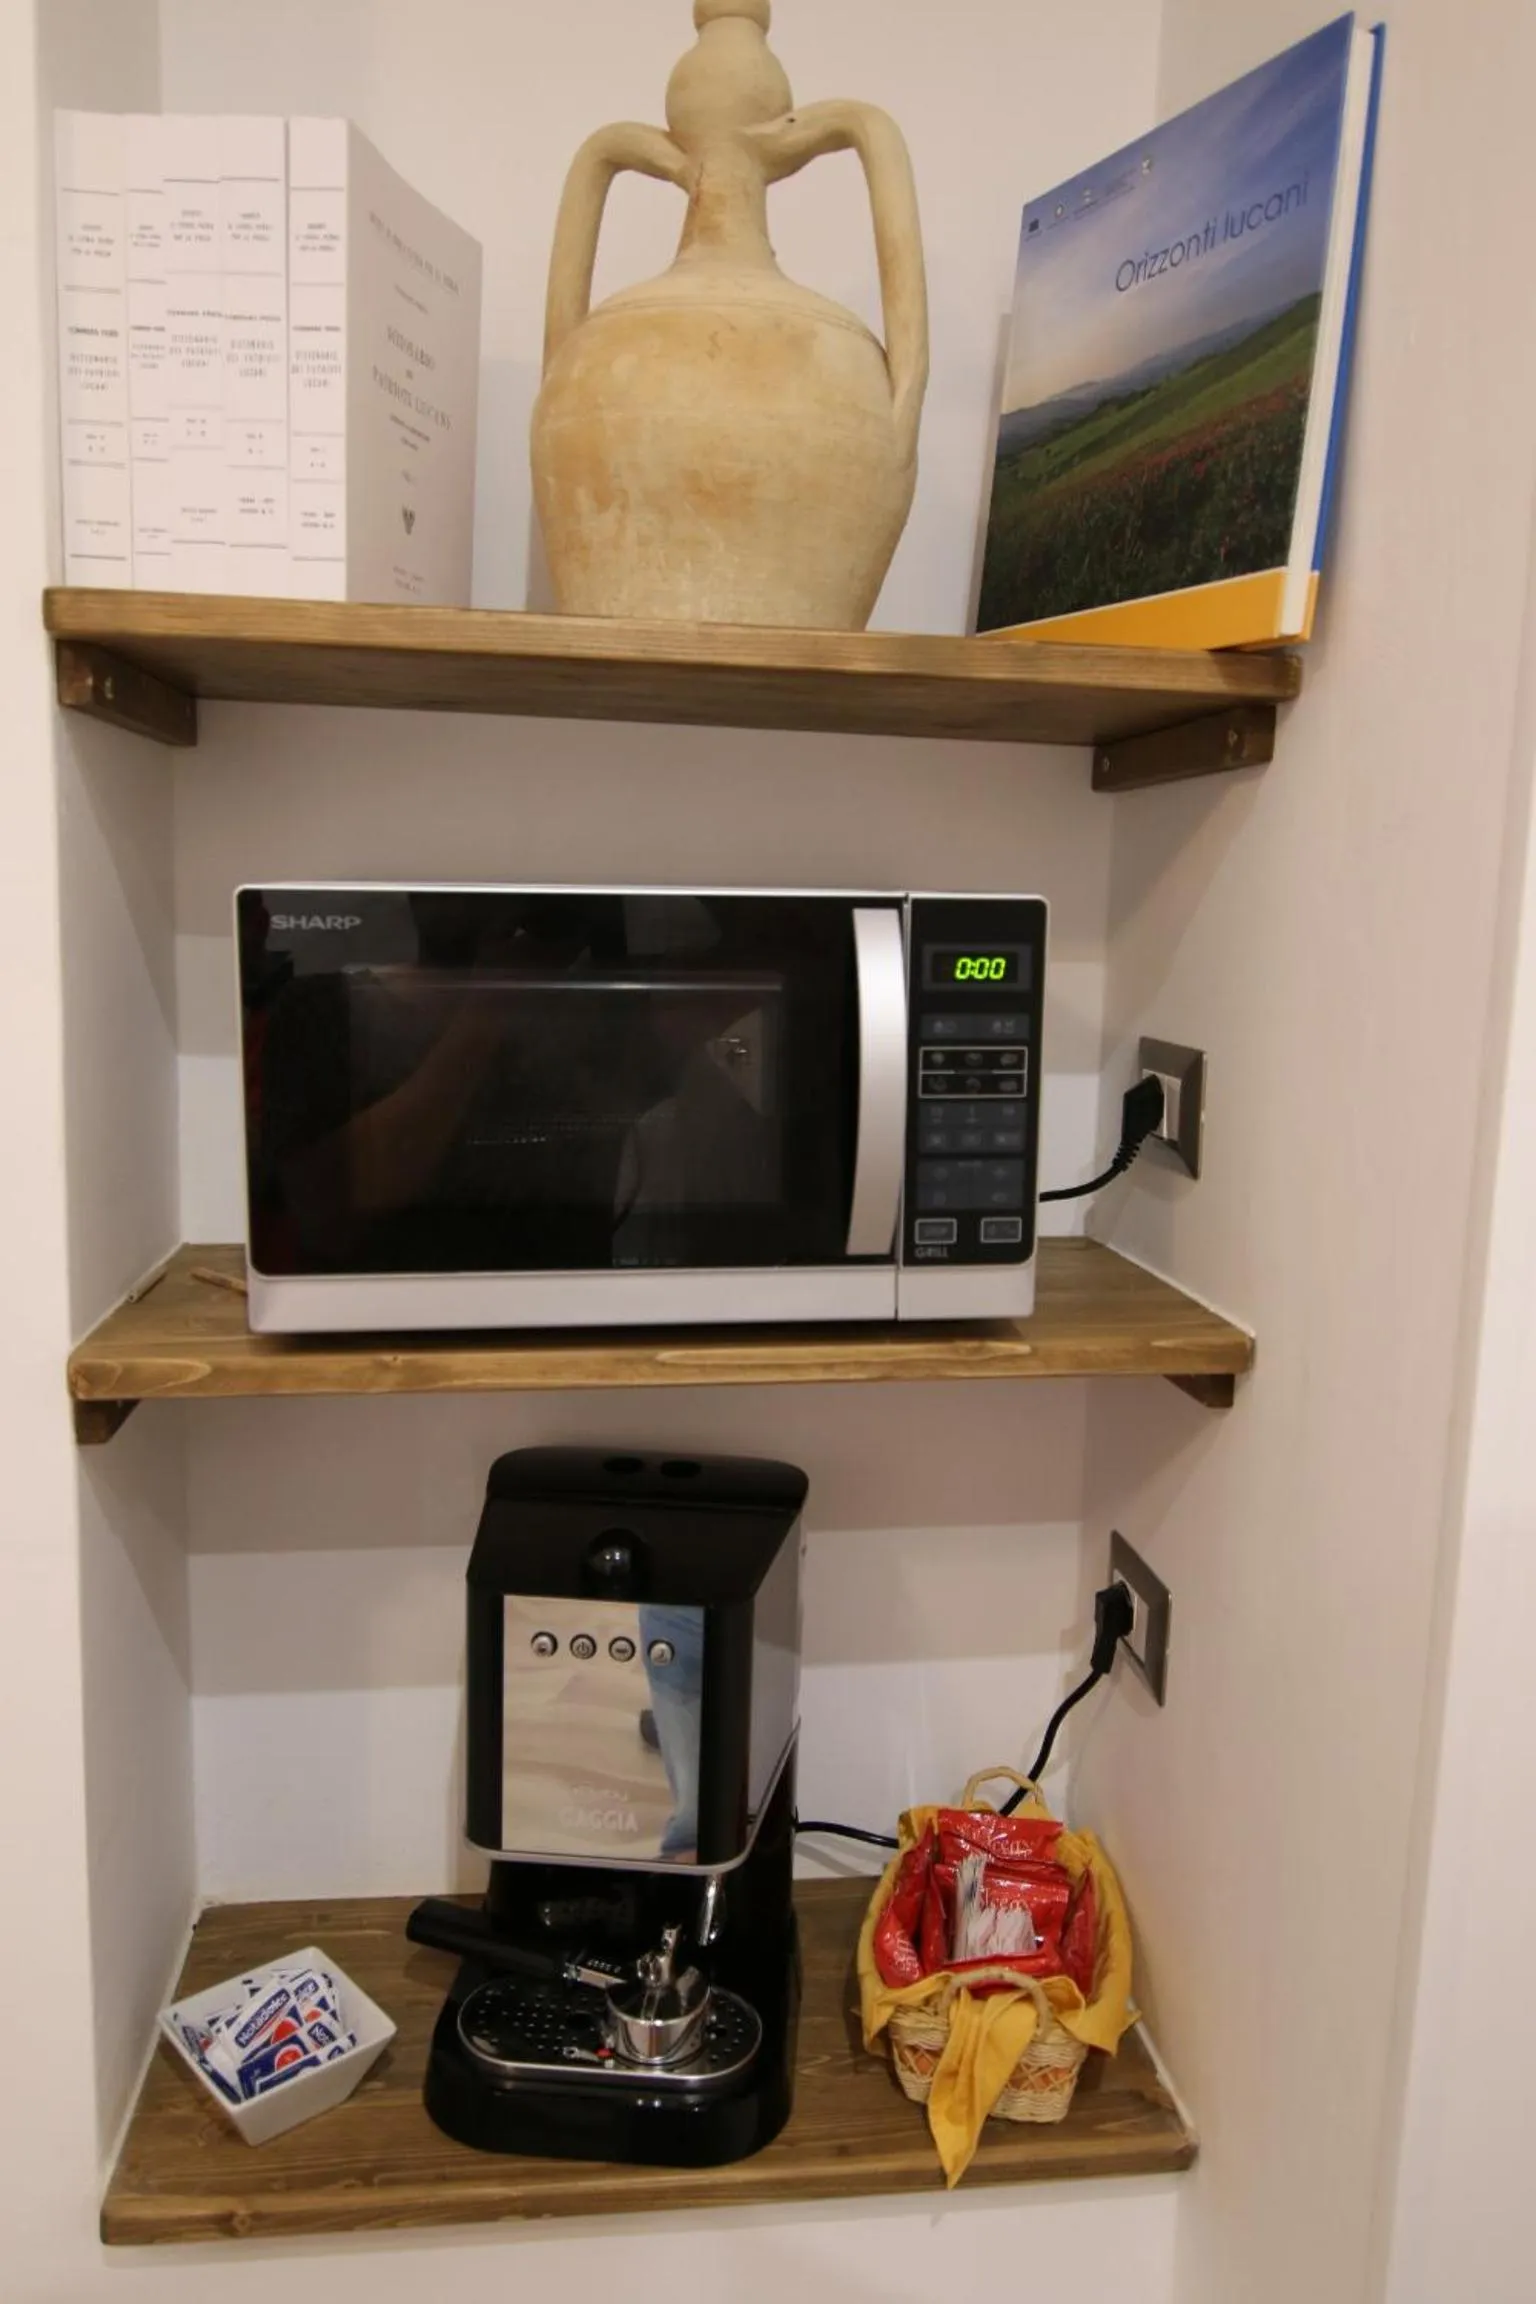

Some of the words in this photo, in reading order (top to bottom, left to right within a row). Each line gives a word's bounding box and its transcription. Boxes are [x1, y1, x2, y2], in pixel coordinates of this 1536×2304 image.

[1115, 217, 1218, 292] Orizzonti
[1223, 171, 1310, 242] lucani
[270, 914, 362, 930] SHARP
[954, 957, 1006, 979] 0:00
[914, 1246, 949, 1258] GRILL
[558, 1806, 639, 1833] GAGGIA
